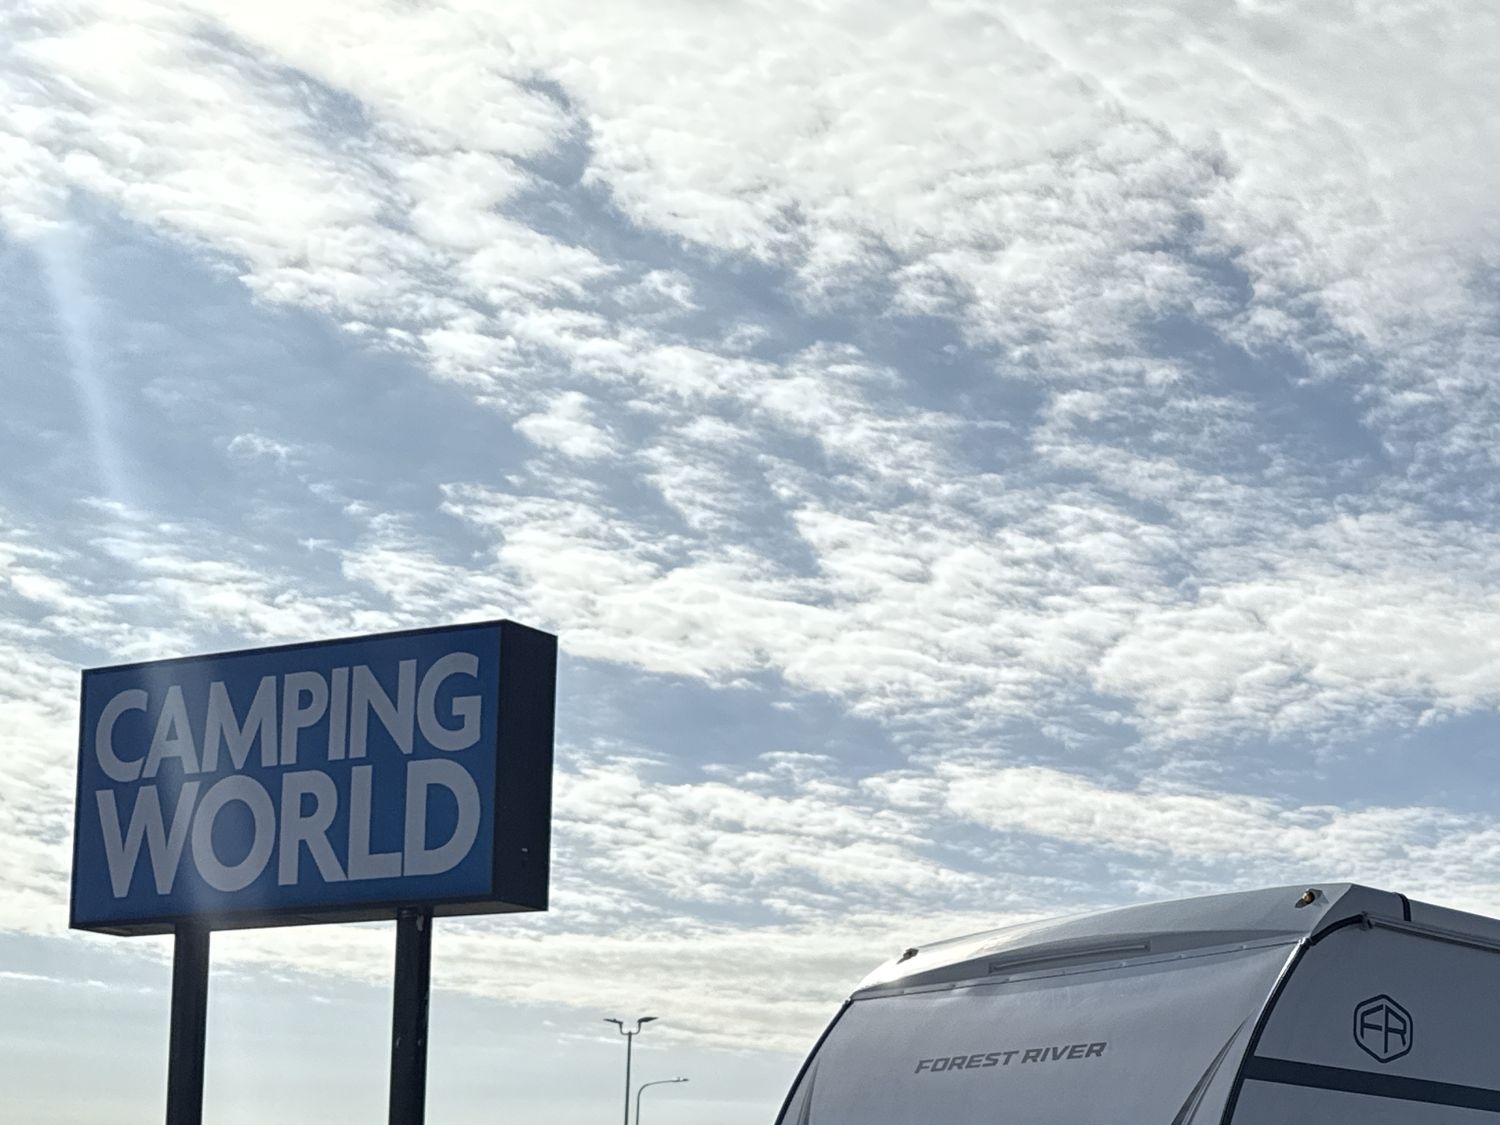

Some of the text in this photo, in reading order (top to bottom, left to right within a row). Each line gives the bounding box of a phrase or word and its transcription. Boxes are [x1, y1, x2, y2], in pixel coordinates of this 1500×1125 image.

[95, 651, 482, 782] CAMPING
[95, 758, 481, 898] WORLD
[914, 1042, 1107, 1074] FOREST RIVER
